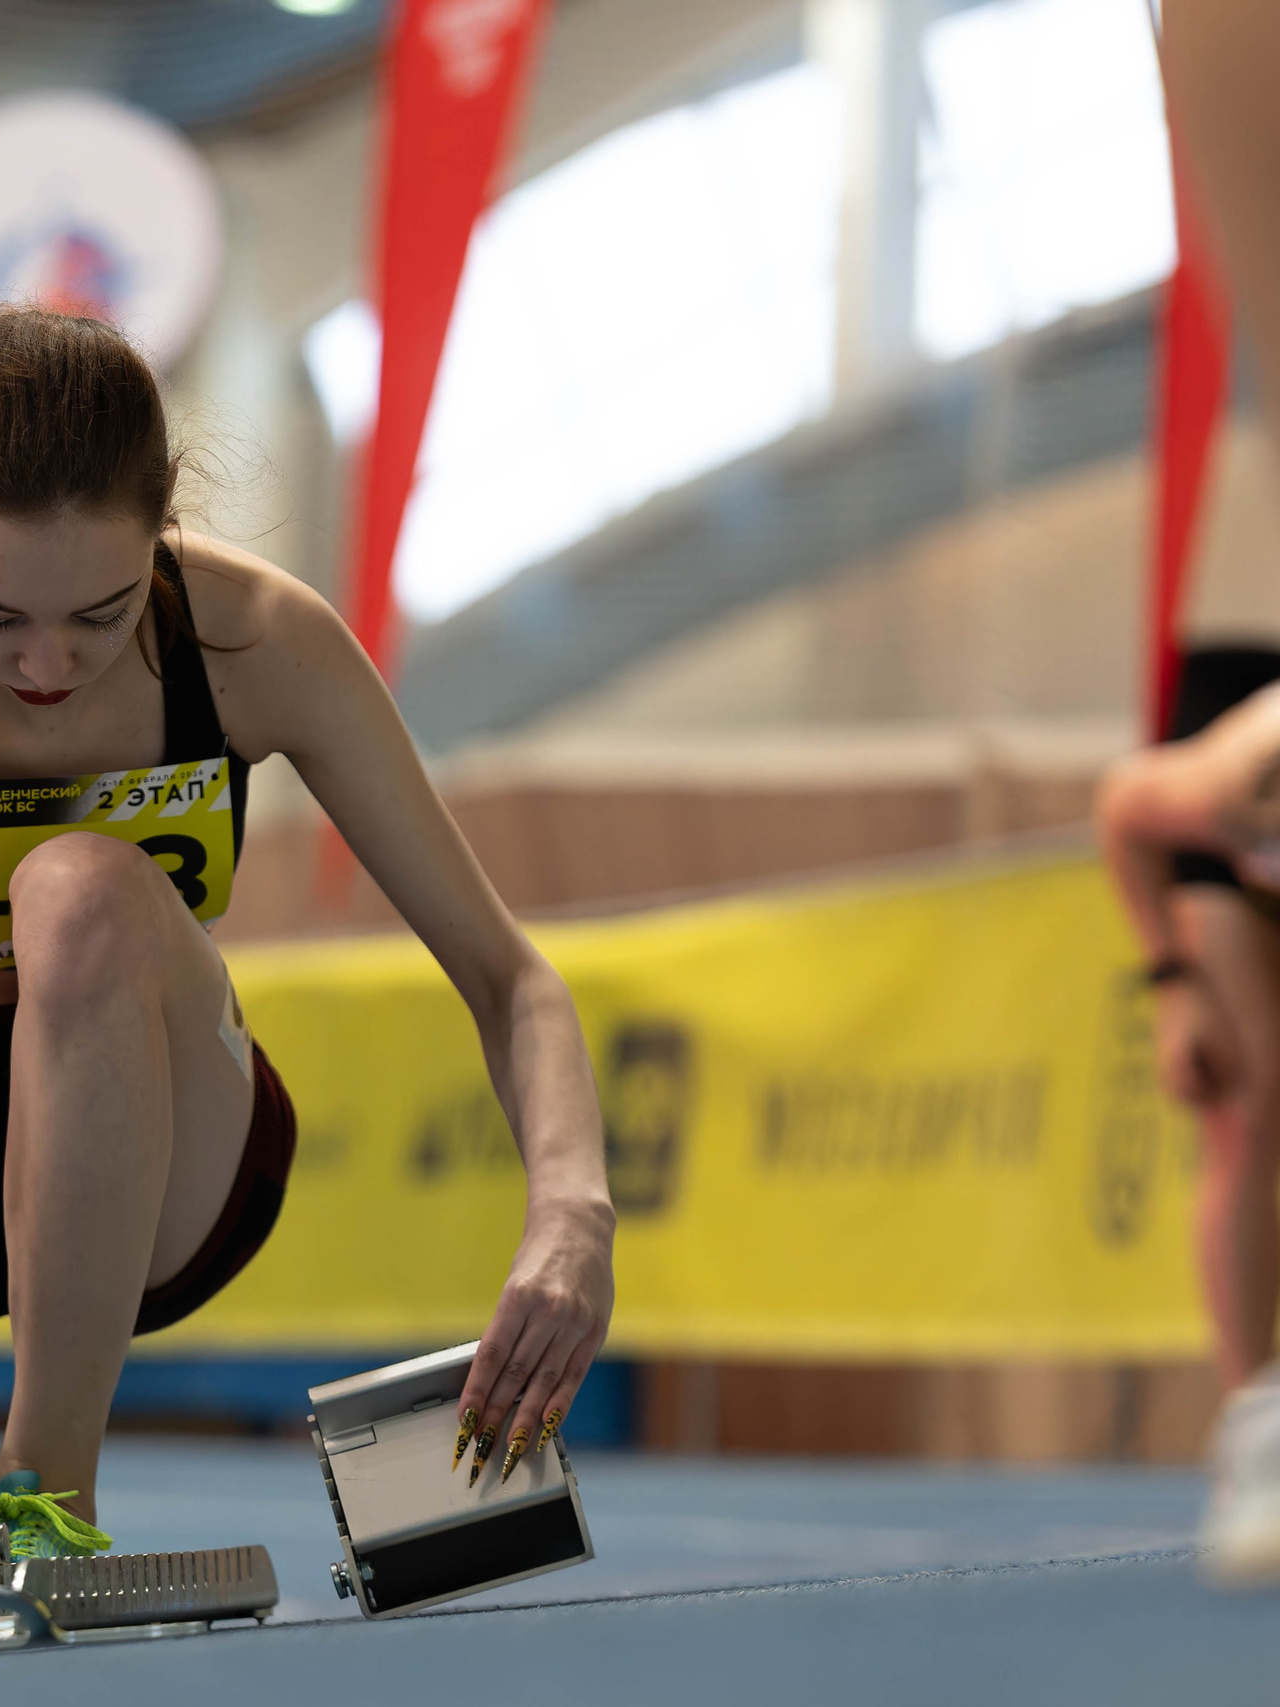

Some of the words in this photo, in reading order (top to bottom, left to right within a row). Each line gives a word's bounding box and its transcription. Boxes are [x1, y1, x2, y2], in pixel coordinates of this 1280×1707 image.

[98, 790, 113, 809] 2
[127, 780, 205, 807] ЭТАП
[16, 801, 36, 813] БС
